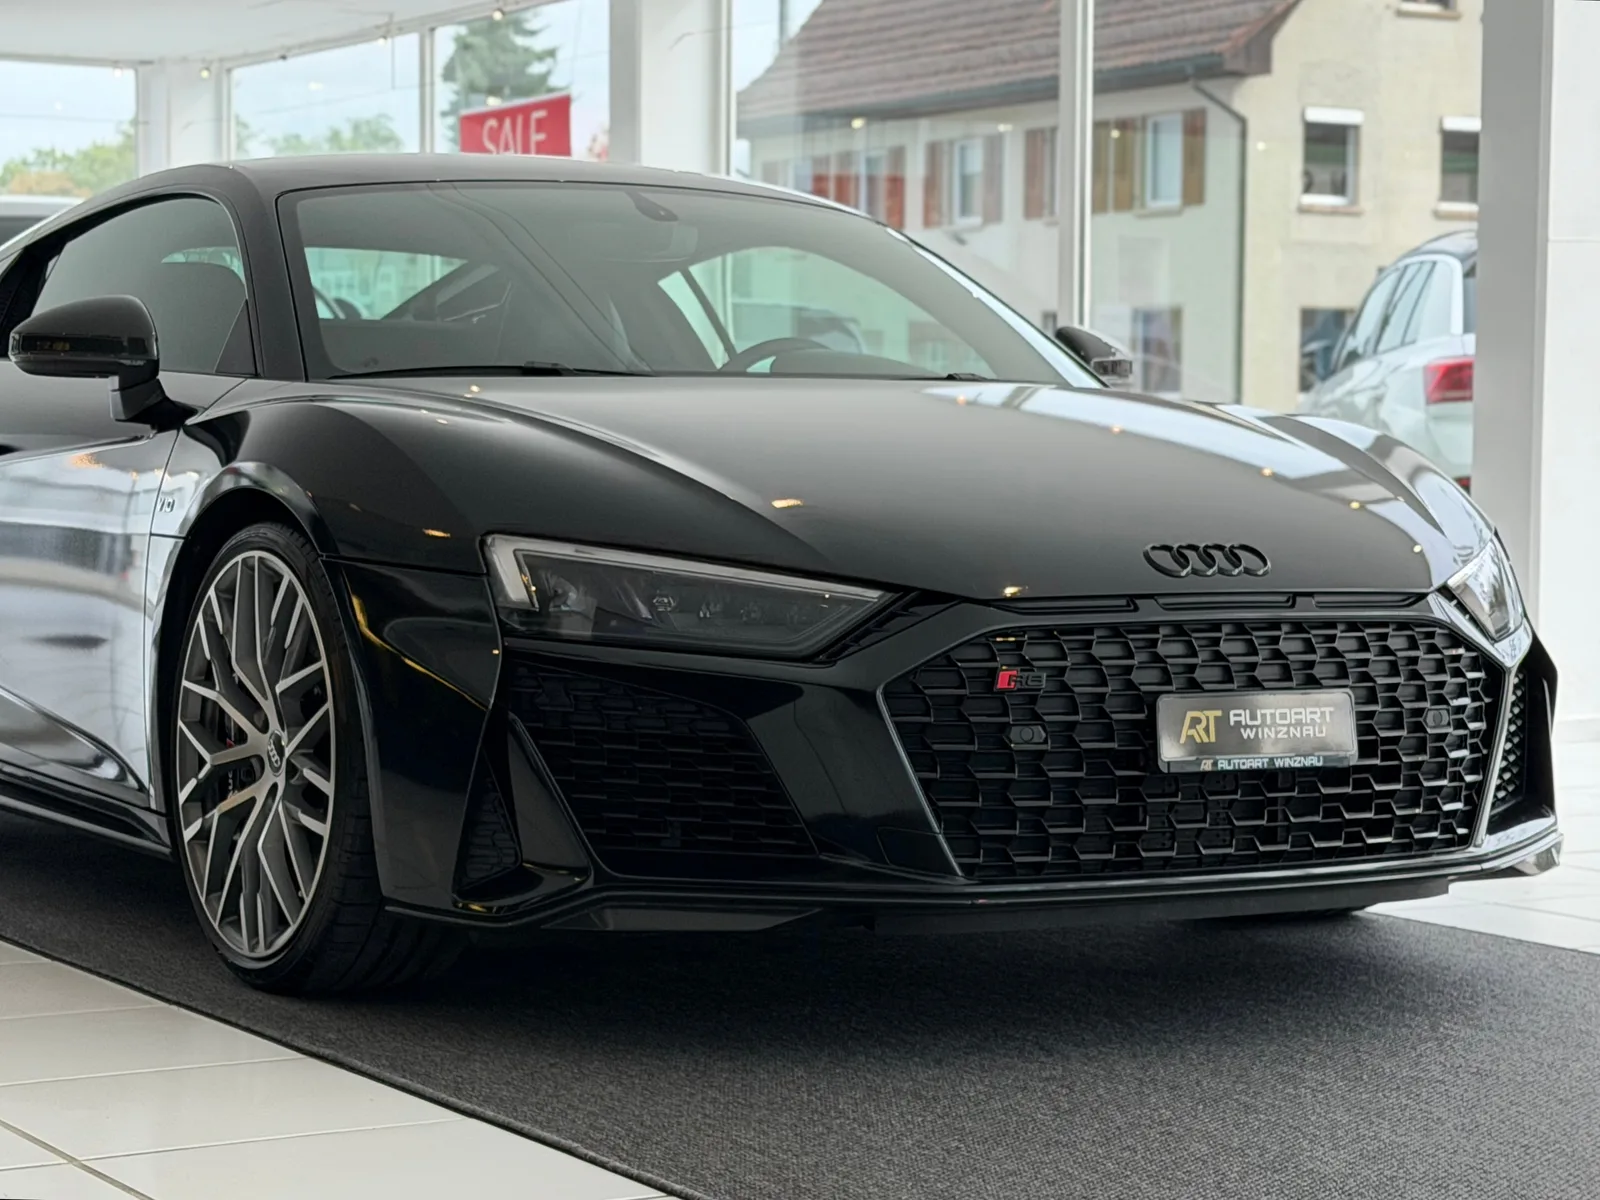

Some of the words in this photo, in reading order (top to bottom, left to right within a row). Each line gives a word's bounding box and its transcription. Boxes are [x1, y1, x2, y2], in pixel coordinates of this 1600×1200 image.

[482, 110, 547, 155] SALE
[1229, 707, 1334, 726] AUTOART
[1241, 726, 1327, 740] WINZNAU
[1217, 758, 1269, 770] AUTOART
[1274, 756, 1323, 768] WINZNAU
